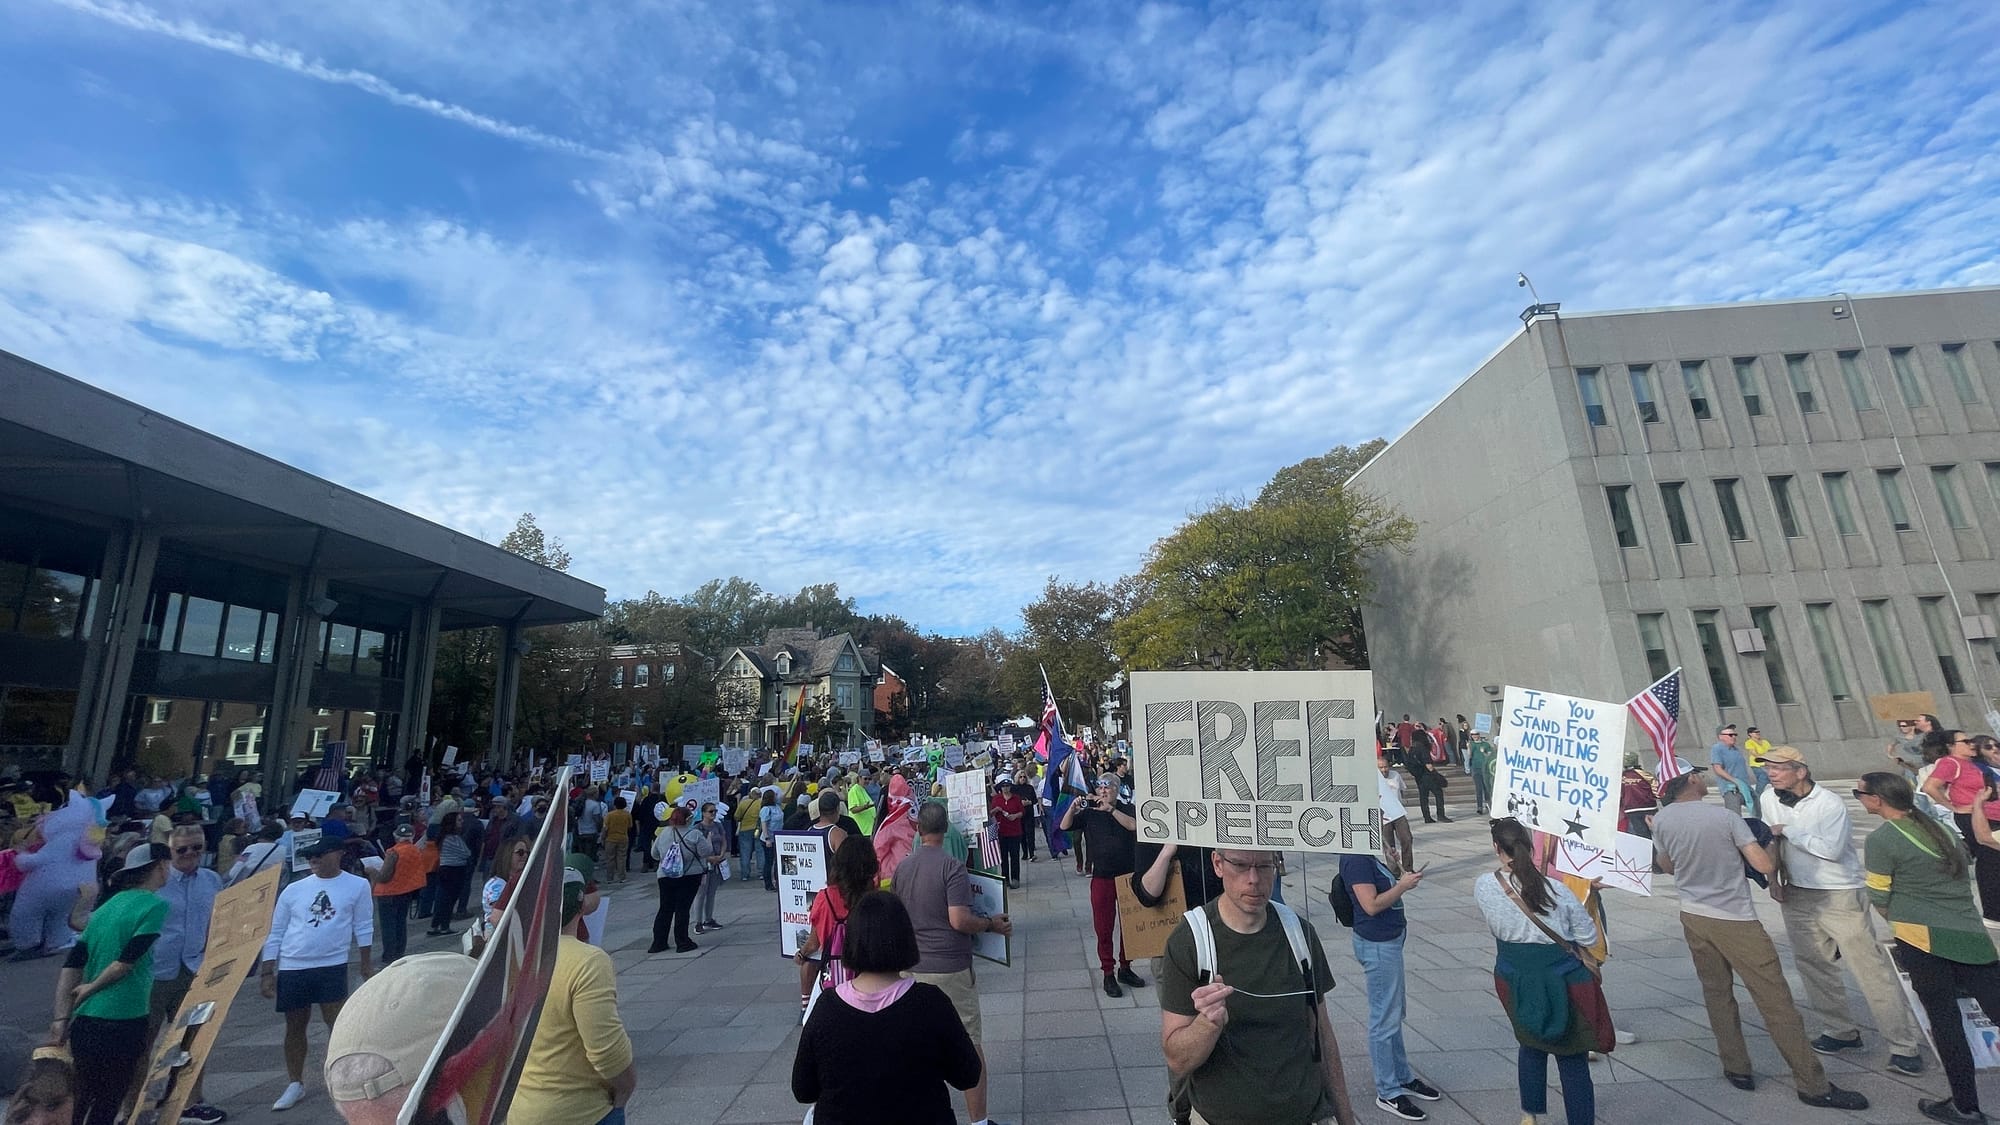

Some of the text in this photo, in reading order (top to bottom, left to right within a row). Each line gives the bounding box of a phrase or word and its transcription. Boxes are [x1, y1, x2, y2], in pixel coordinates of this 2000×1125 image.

[1524, 691, 1595, 720] IF YOU
[1510, 708, 1561, 734] STAND
[1566, 719, 1600, 743] FOR
[1145, 699, 1359, 803] FREE
[1521, 731, 1600, 763] NOTHING
[1504, 747, 1543, 773] WHAT
[1545, 757, 1580, 782] WILL
[1581, 765, 1609, 789] YOU
[1509, 769, 1609, 812] FALL FOR?
[1140, 799, 1382, 850] SPEECH
[783, 842, 817, 853] OUR NATION
[798, 857, 813, 868] WAS
[791, 879, 812, 891] BUILT
[794, 895, 804, 906] BY
[783, 911, 811, 925] IMMIGR
